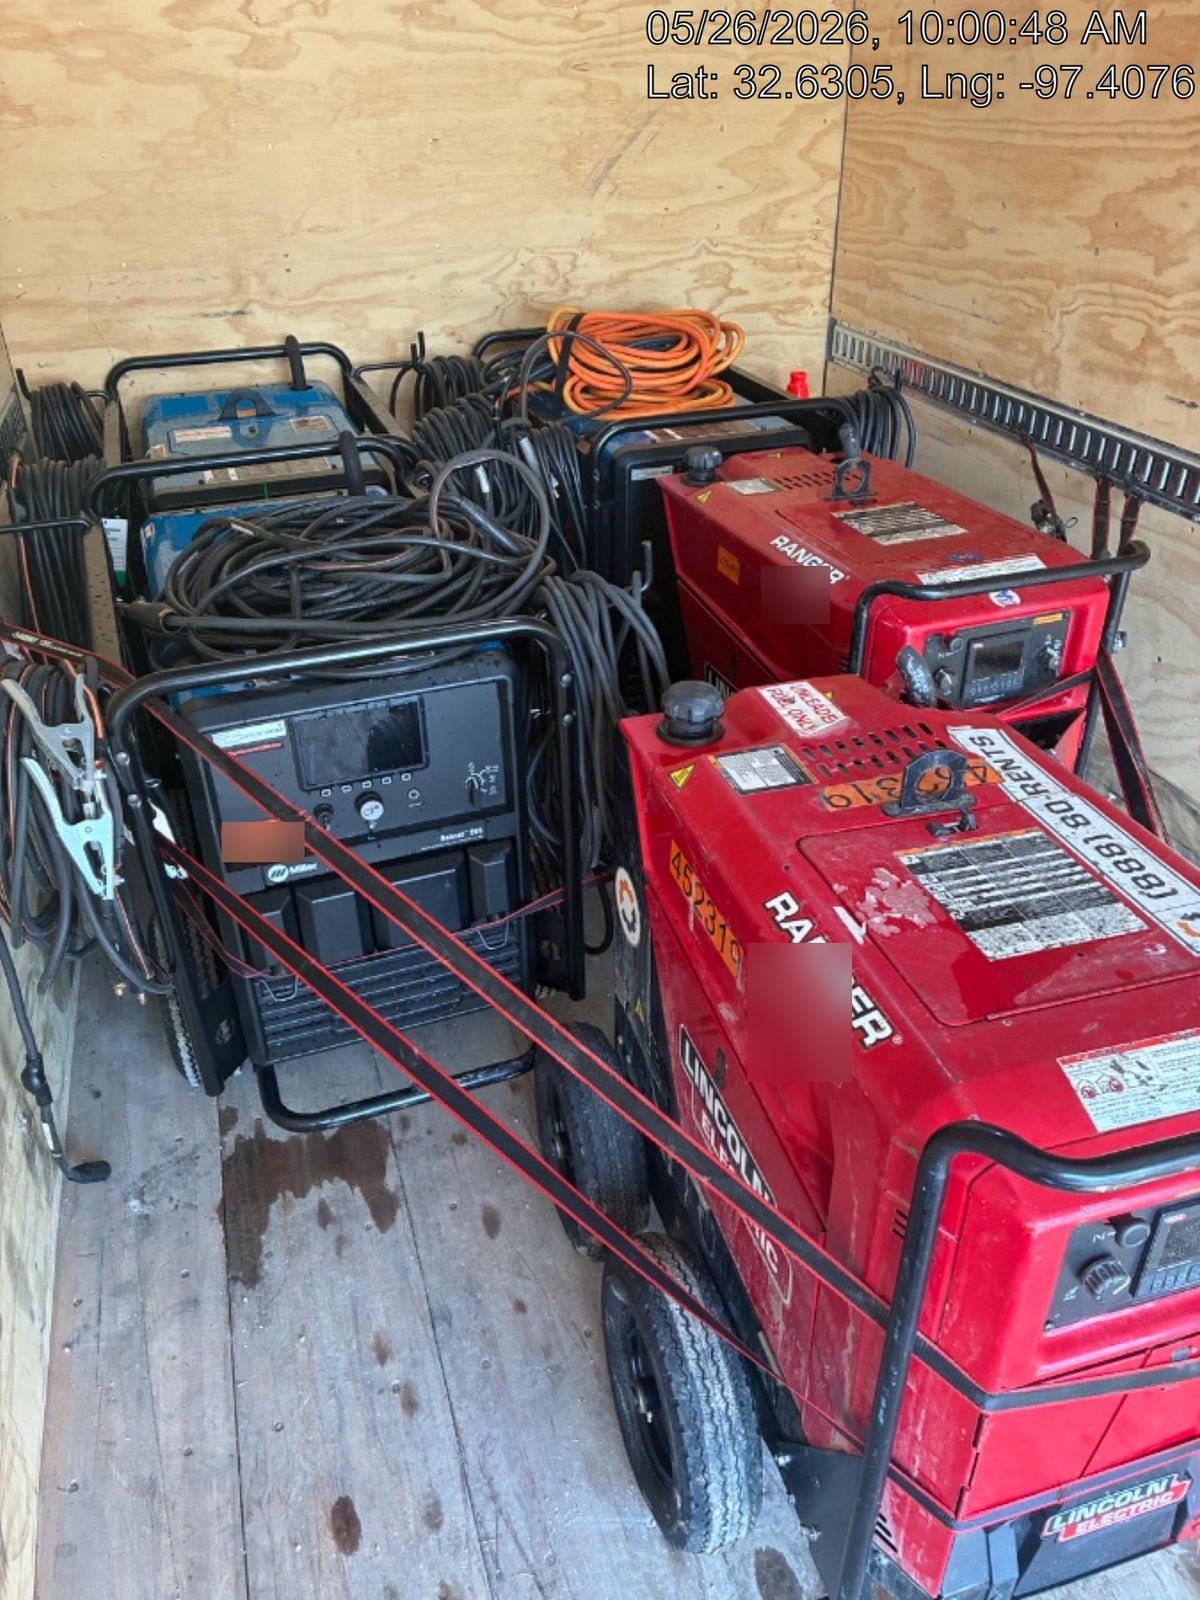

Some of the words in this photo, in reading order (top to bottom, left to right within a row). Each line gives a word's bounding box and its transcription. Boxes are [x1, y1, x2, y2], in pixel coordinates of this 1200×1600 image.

[968, 735, 1092, 831] 80-RENTS
[1082, 833, 1179, 900] (888)
[670, 853, 741, 970] 452319
[1051, 1479, 1169, 1530] LINCOLN
[1074, 1491, 1175, 1535] ELECTRIC
